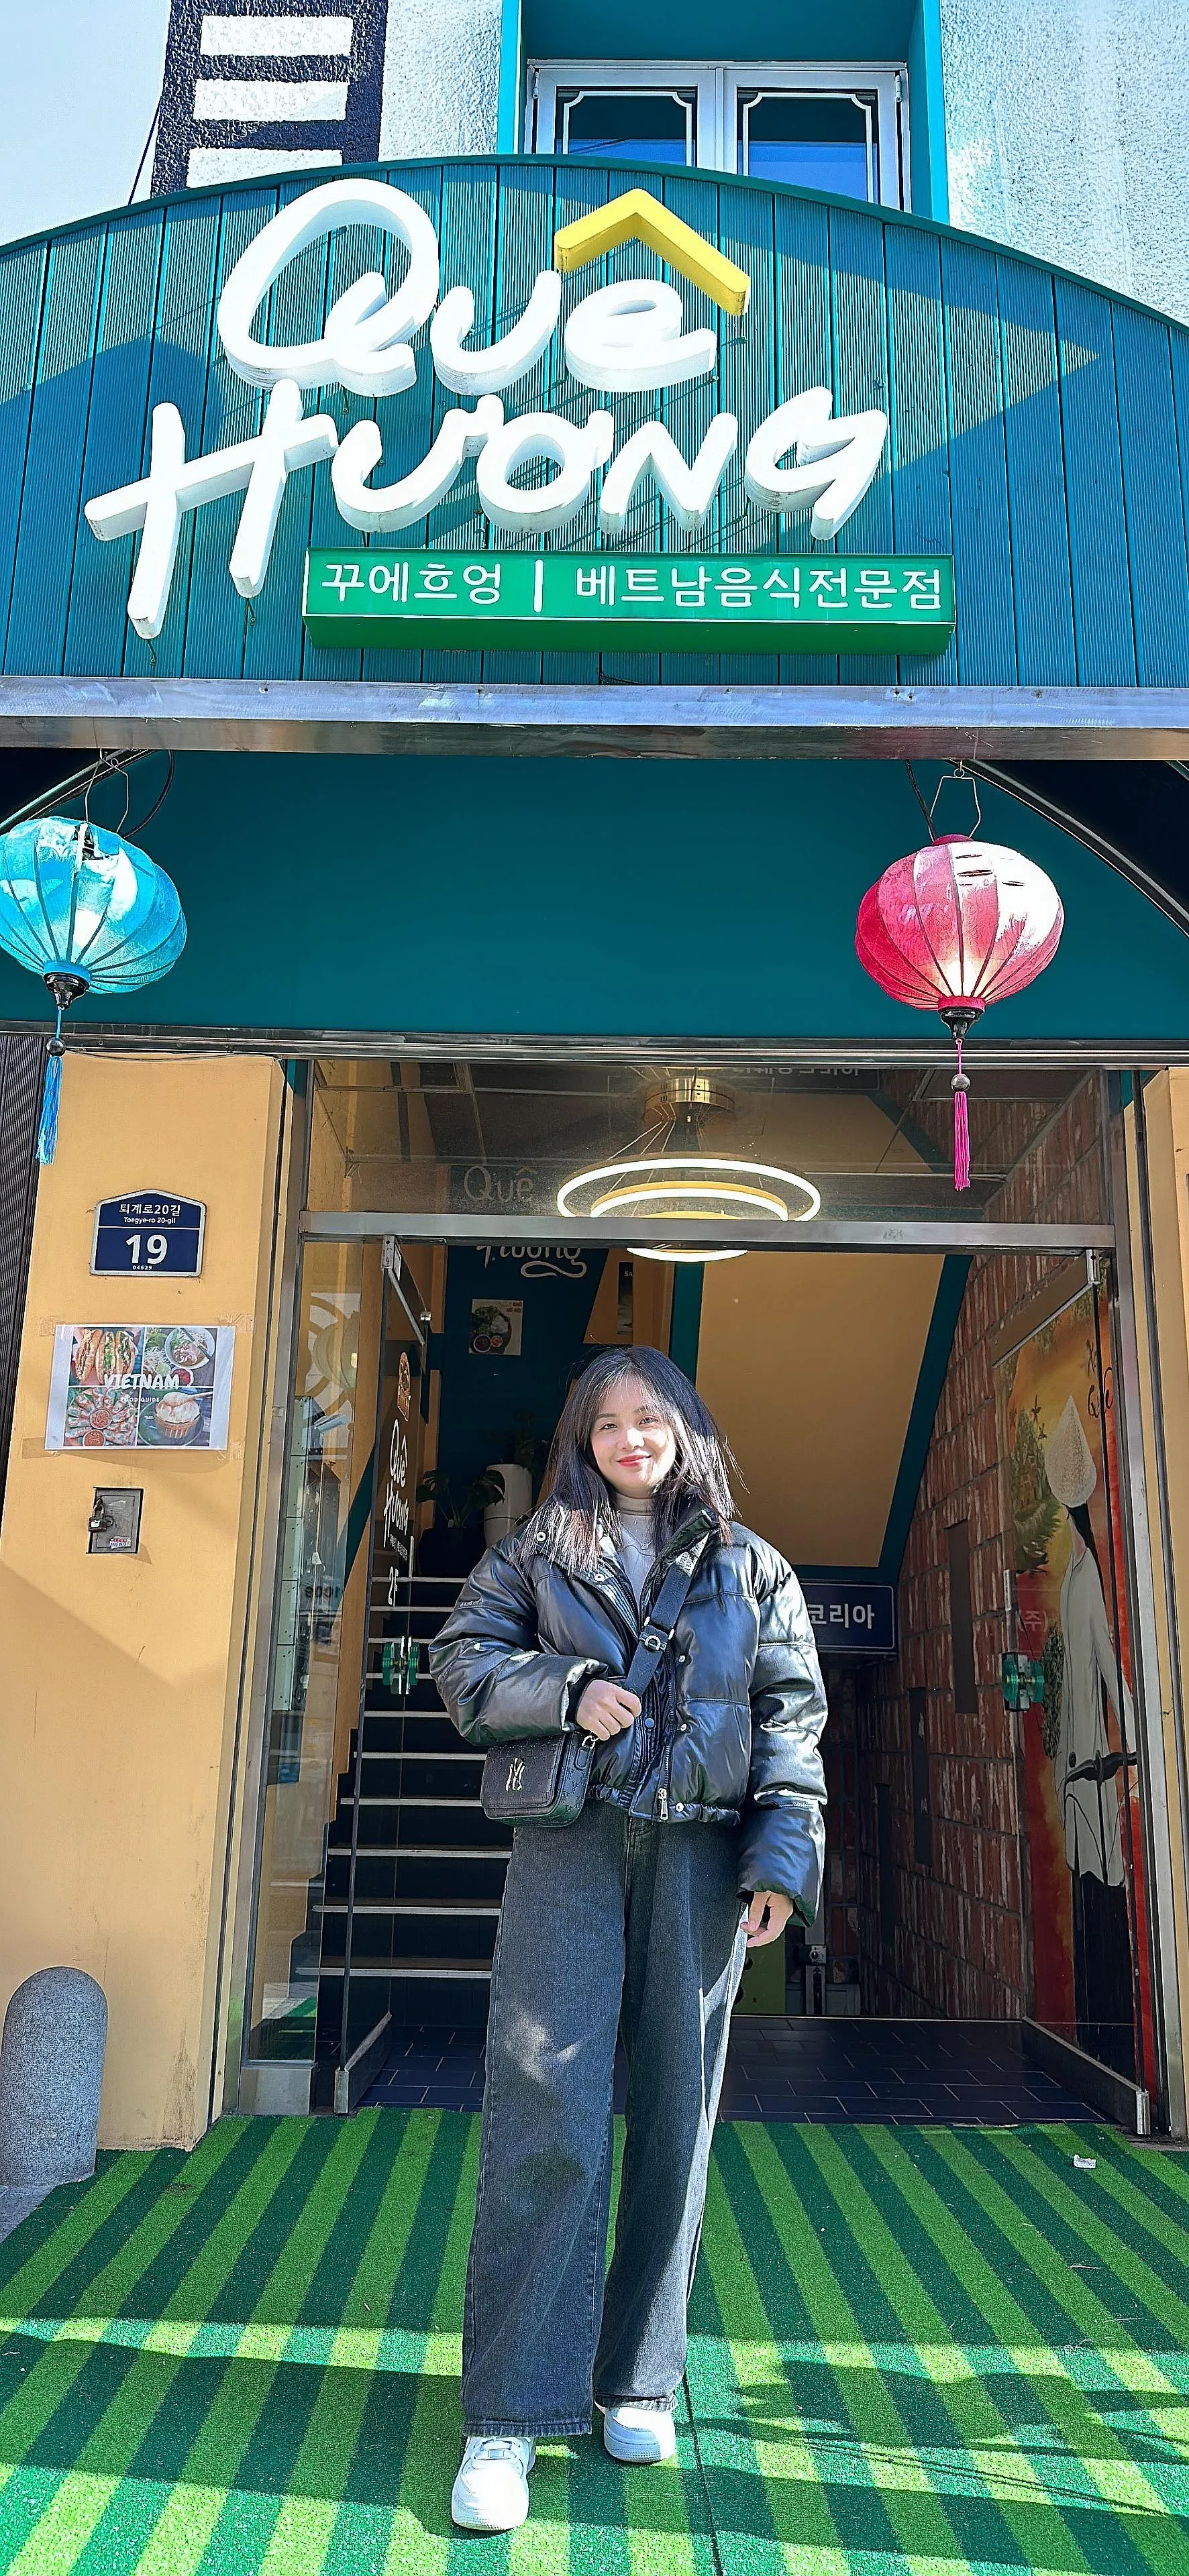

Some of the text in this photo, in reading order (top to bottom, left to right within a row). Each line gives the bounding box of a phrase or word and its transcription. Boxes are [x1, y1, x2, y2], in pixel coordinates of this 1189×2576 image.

[216, 177, 750, 397] Quê
[321, 561, 943, 611] 꾸에흐엉 베트남음식전문점
[119, 1203, 180, 1217] 퇴계로20길
[123, 1216, 176, 1225] Toegye-ro 20-gil
[125, 1234, 168, 1265] 19
[104, 1373, 180, 1390] VIETNAM
[388, 1566, 399, 1607] 2F
